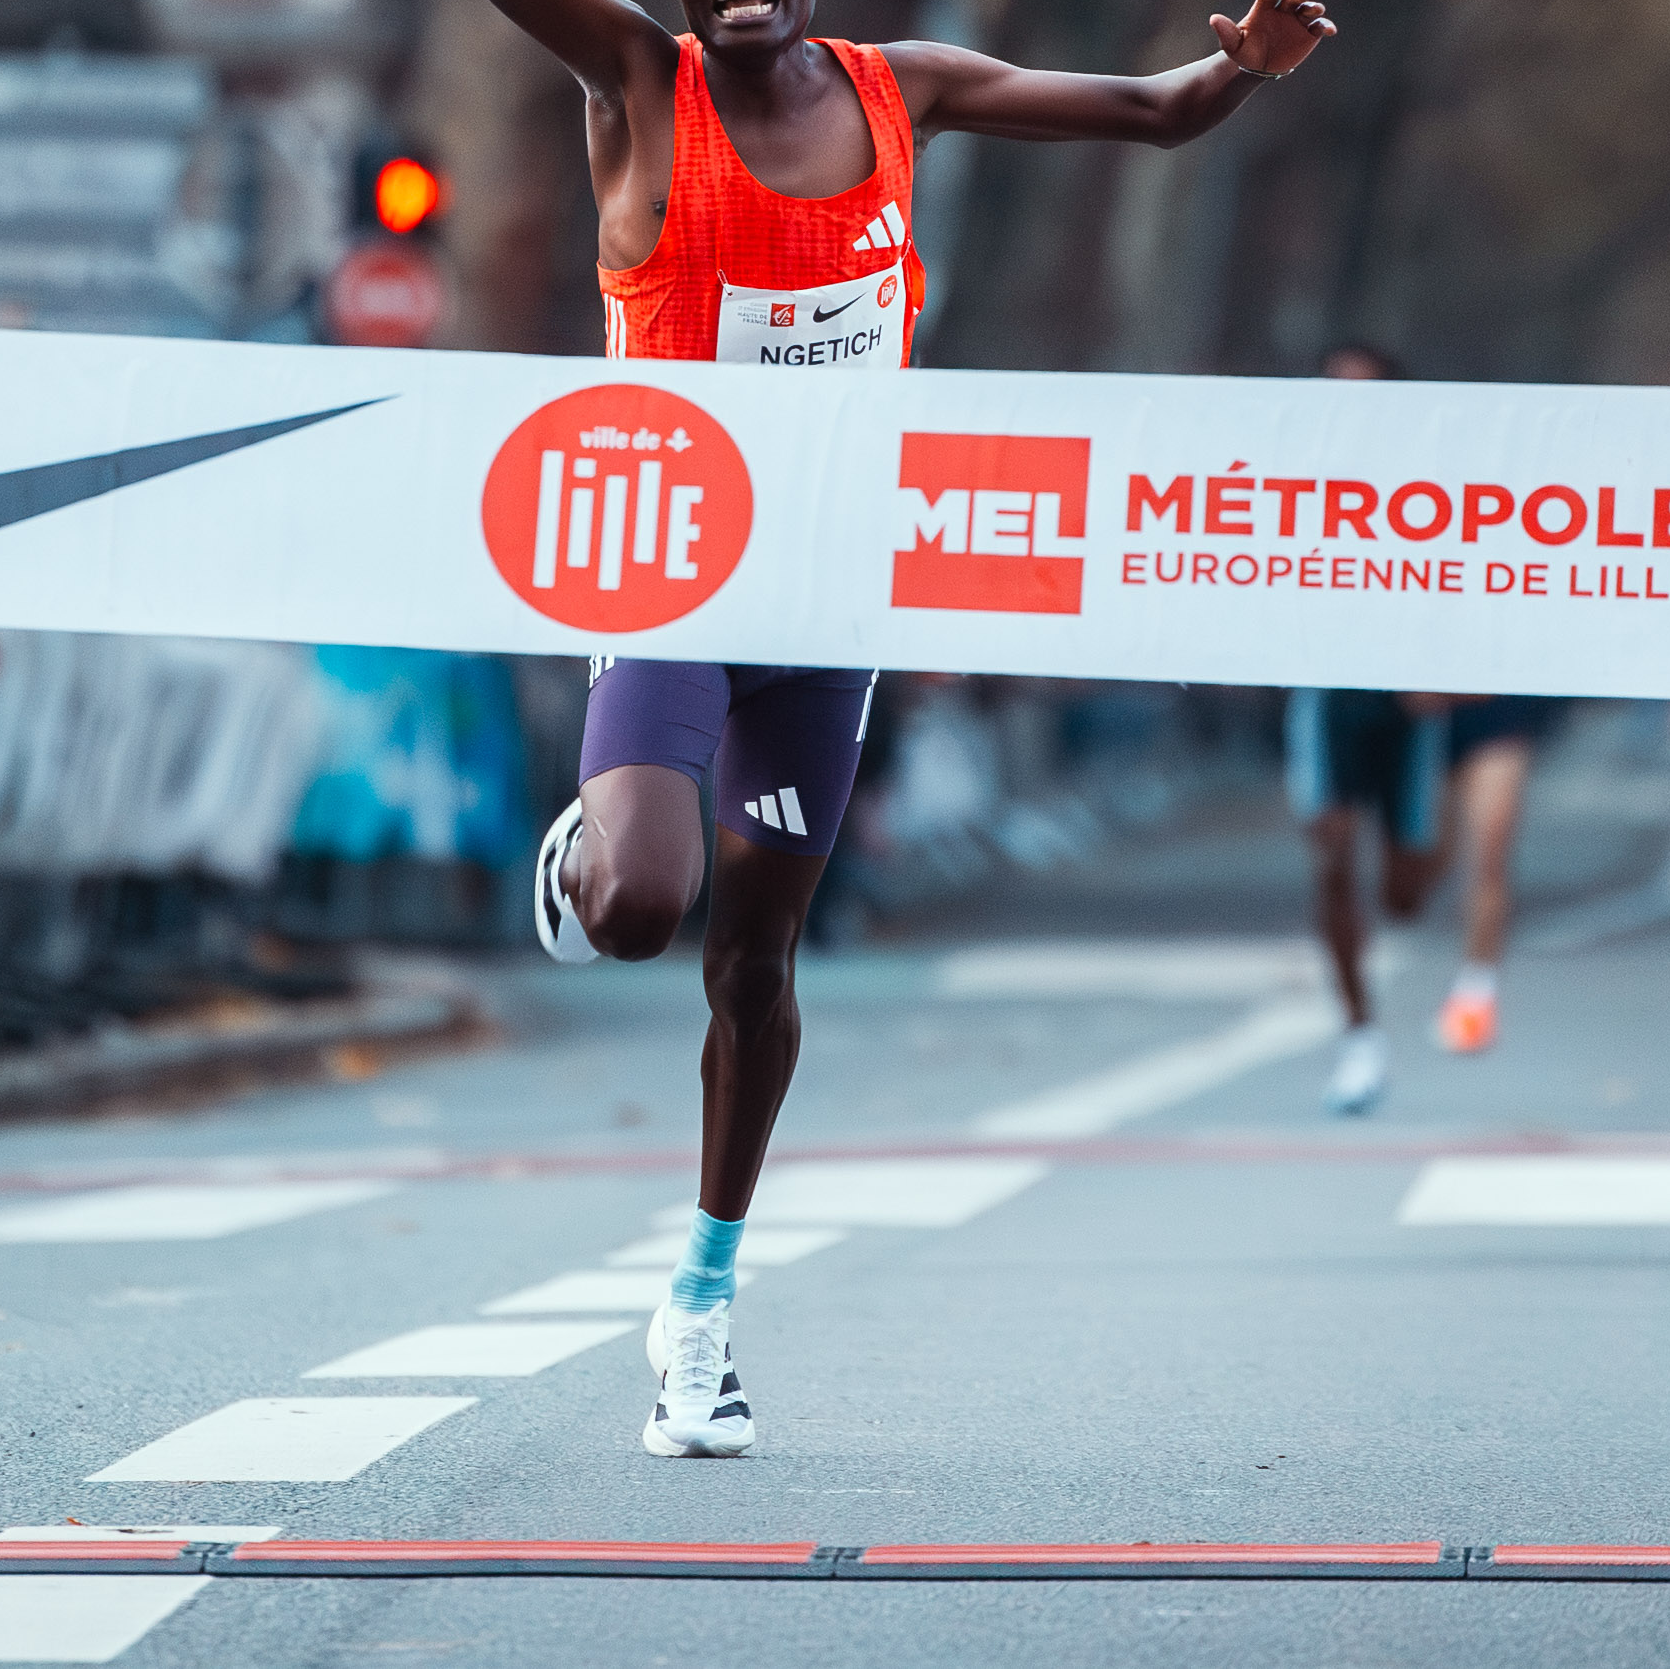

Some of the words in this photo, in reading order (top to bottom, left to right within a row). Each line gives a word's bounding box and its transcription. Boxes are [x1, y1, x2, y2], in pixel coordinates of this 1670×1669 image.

[760, 324, 882, 366] NGETICH
[579, 426, 630, 450] ville
[631, 427, 661, 451] de
[895, 486, 1085, 559] MEL
[1121, 546, 1465, 594] EUROPÉENNE
[1484, 561, 1549, 597] DE
